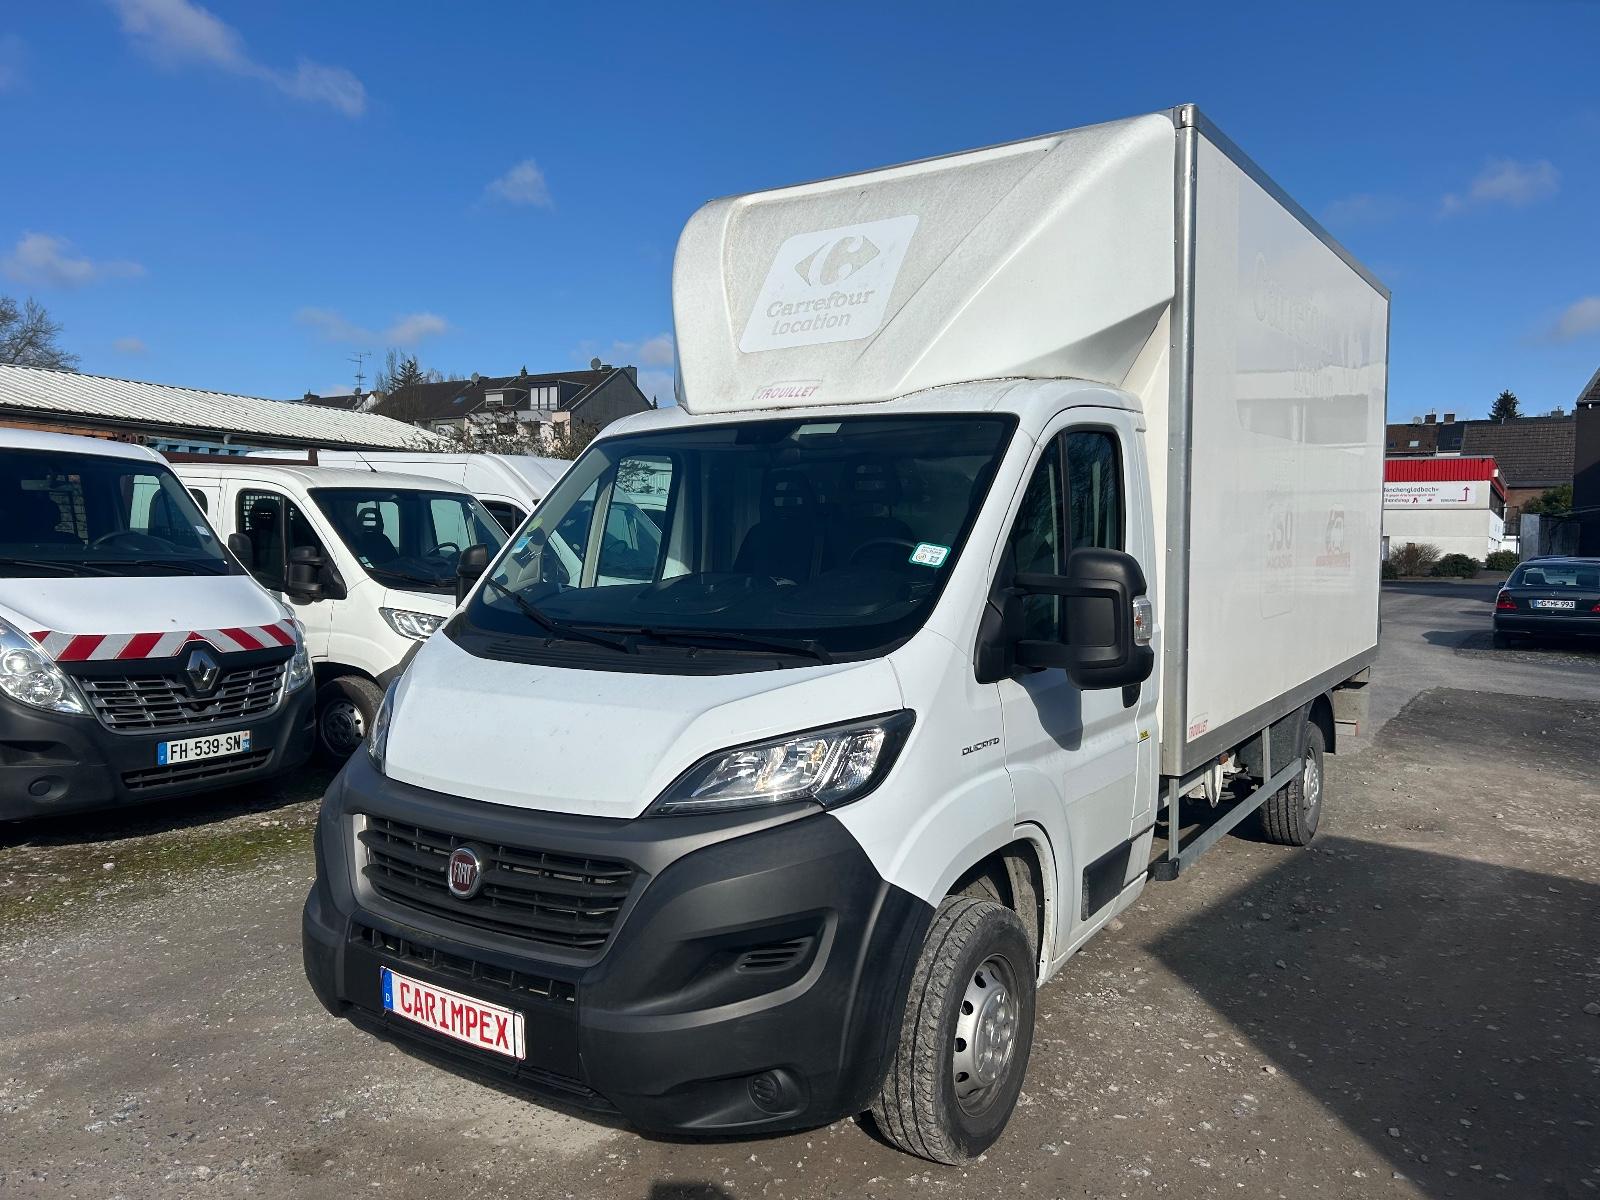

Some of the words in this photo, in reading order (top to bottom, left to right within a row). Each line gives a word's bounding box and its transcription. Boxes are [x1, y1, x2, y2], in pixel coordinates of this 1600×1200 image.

[766, 290, 875, 318] Carrefour
[772, 312, 850, 336] Location
[962, 737, 1000, 755] DUCATO
[453, 861, 474, 884] FIAT
[385, 992, 391, 1002] D
[400, 982, 509, 1050] CARIMPEX
